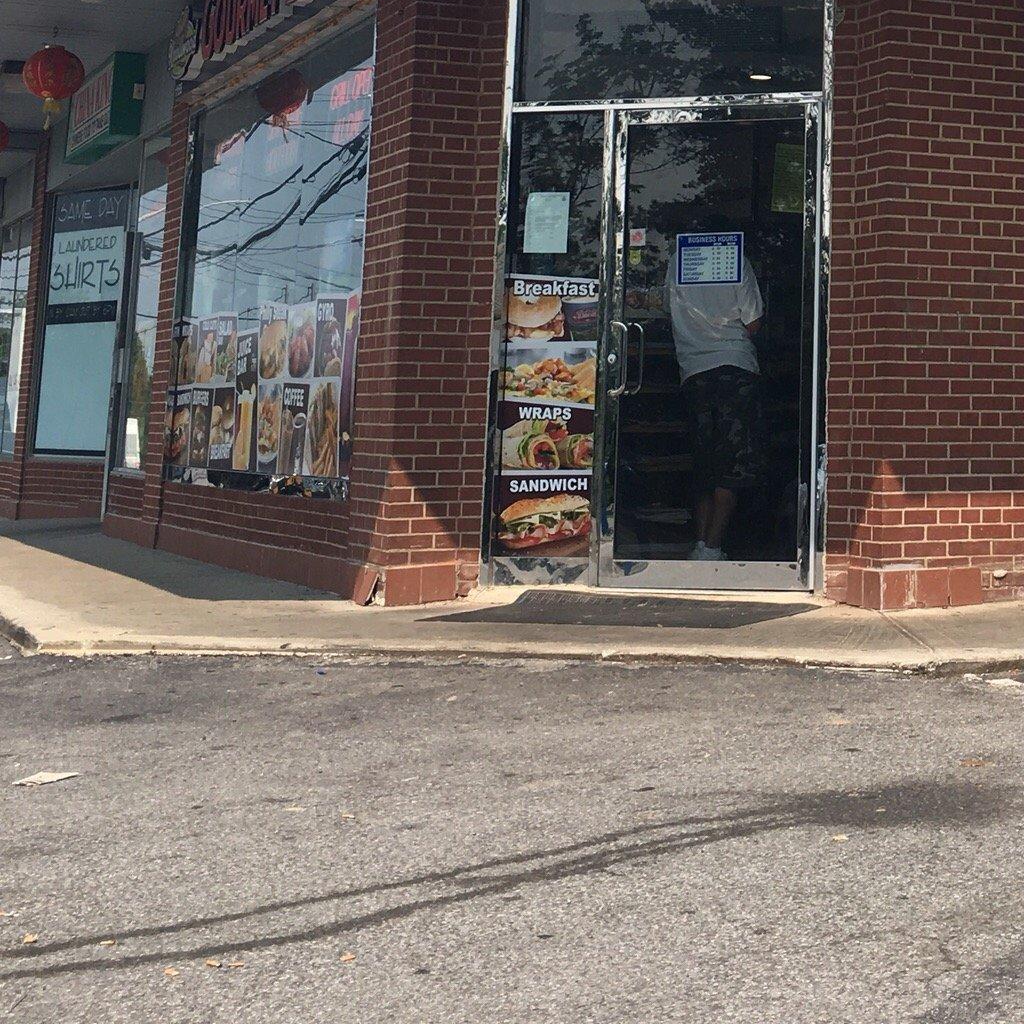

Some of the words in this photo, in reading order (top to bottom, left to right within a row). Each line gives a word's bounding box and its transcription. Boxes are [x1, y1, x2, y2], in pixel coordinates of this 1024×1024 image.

[58, 199, 93, 222] SAME
[98, 196, 123, 220] DAY
[58, 235, 117, 254] LAUNDERED
[688, 236, 717, 244] BUSINESS
[50, 256, 120, 294] SHIRTS
[513, 279, 596, 297] Breakfast
[317, 302, 334, 322] GYRO
[284, 387, 304, 407] COFFEE
[518, 406, 572, 421] WRAPS
[509, 477, 588, 493] SANDWICH
